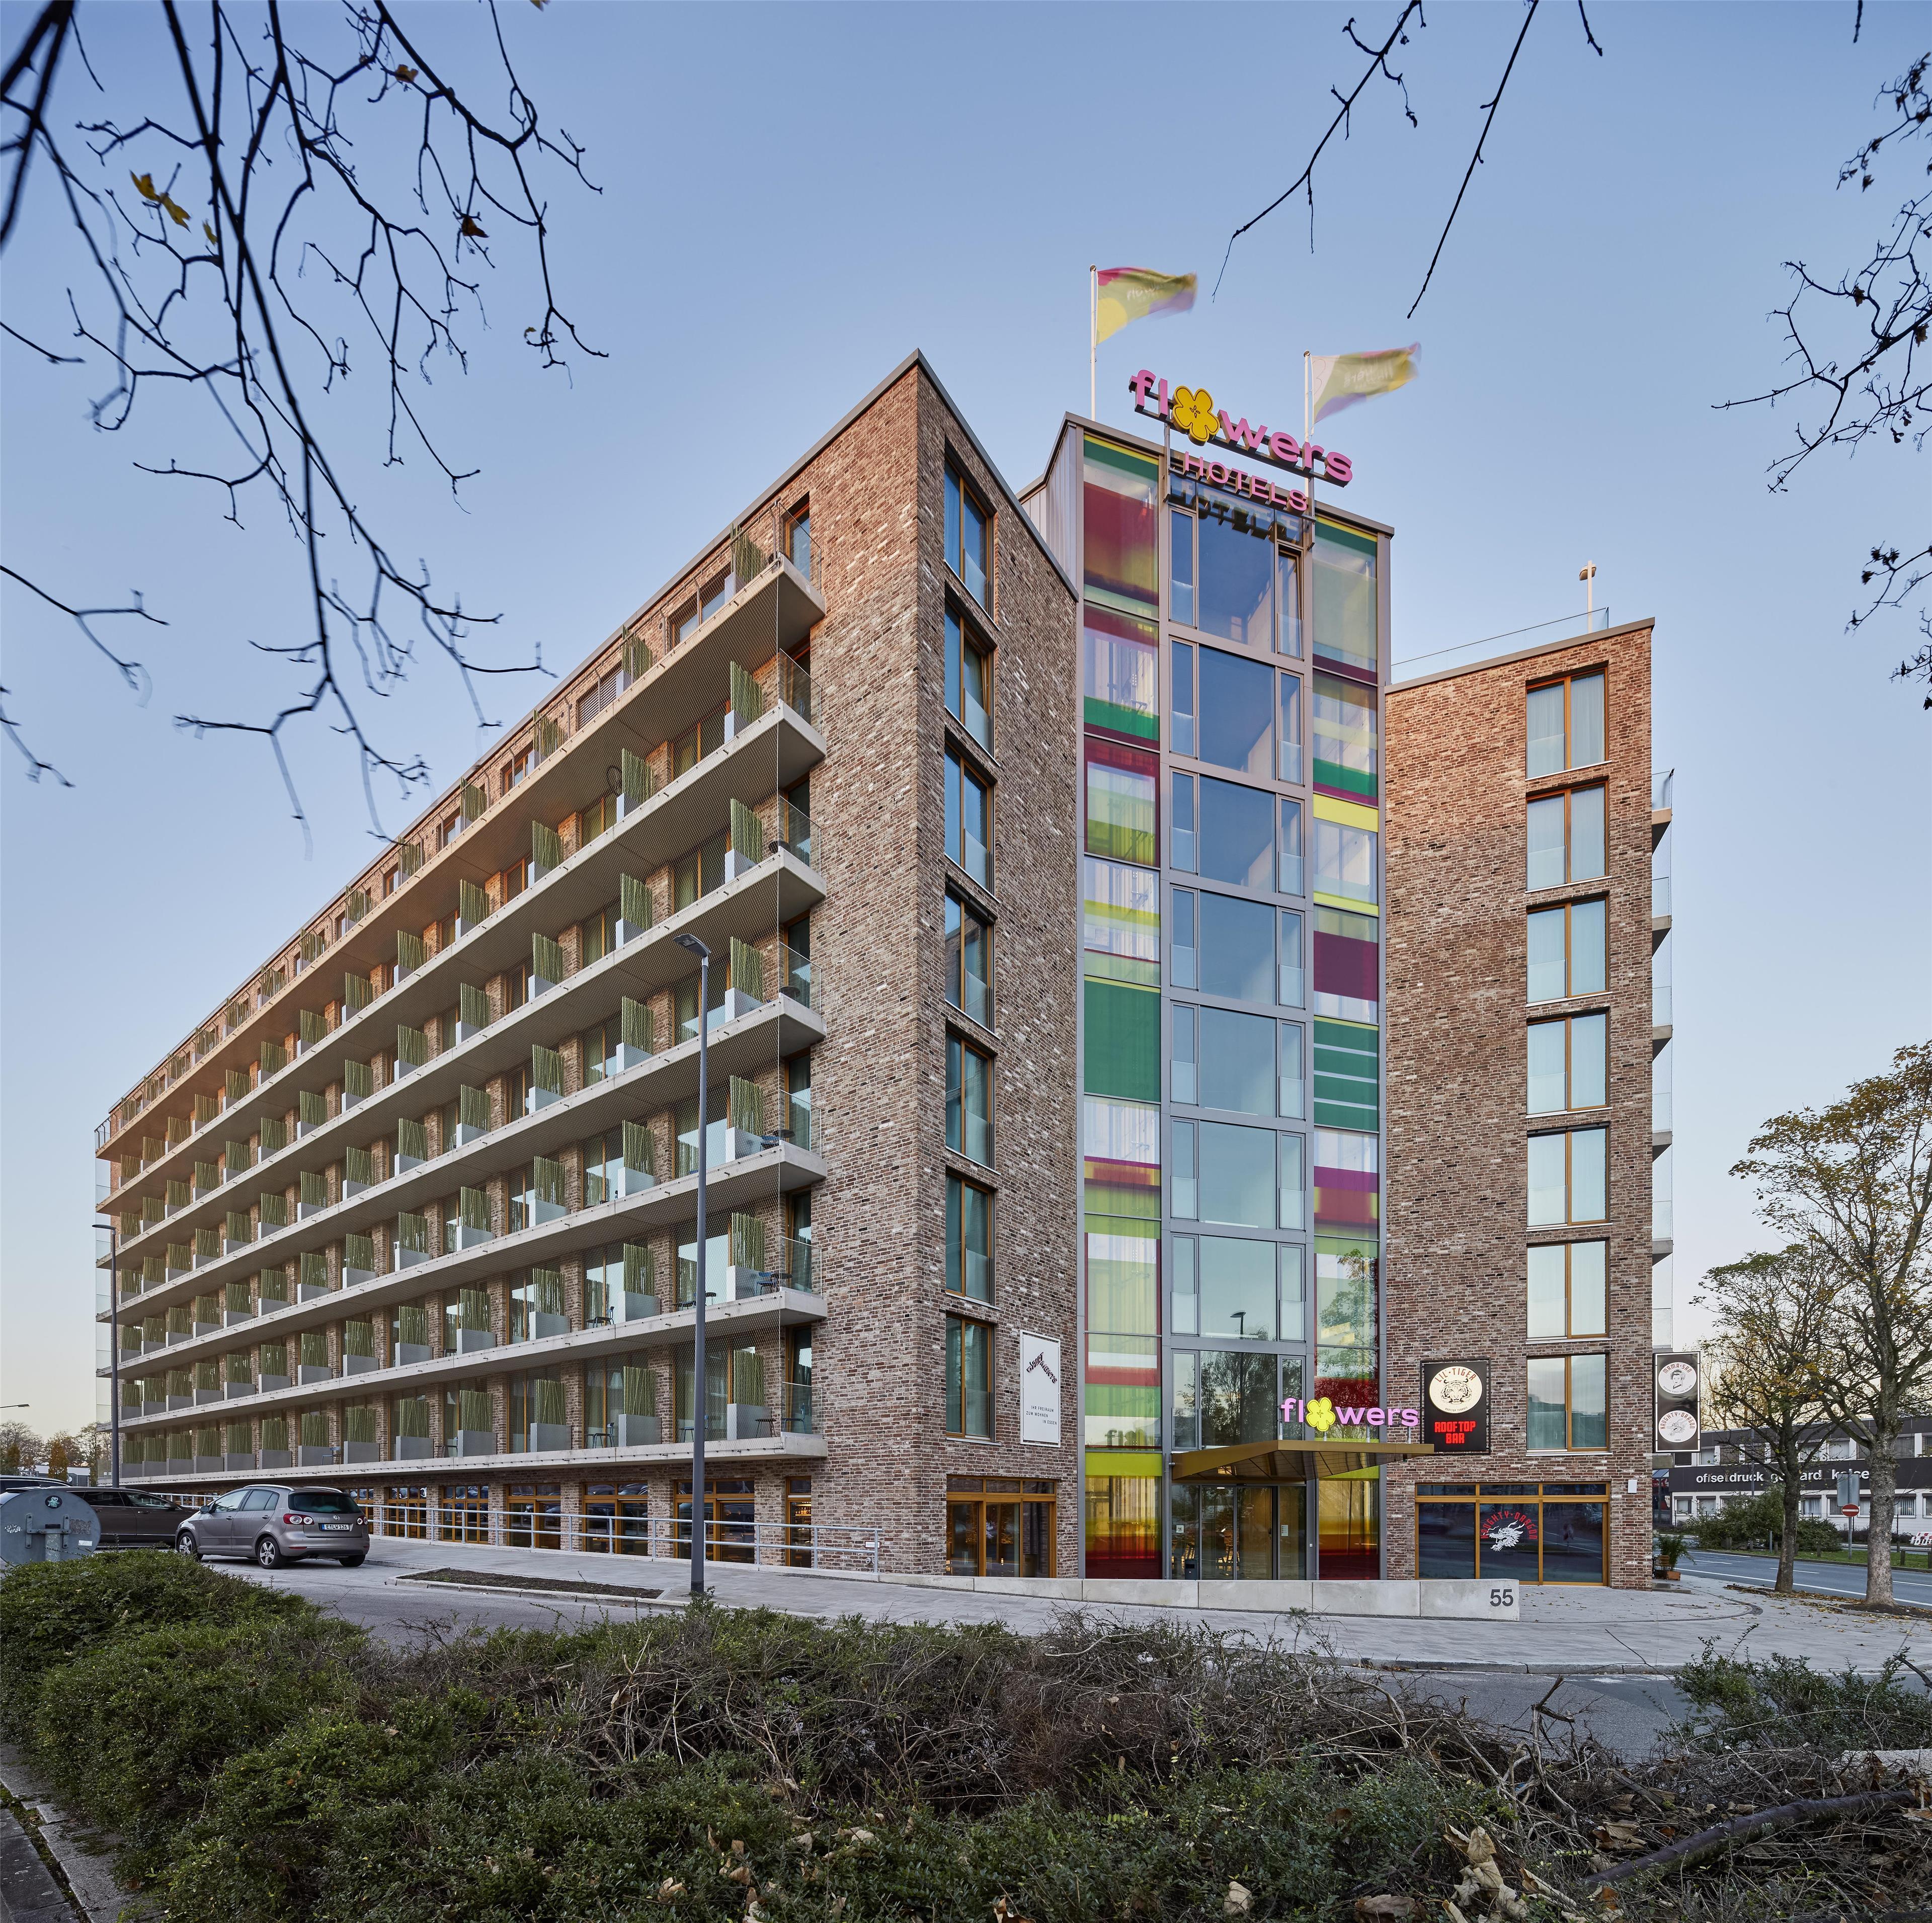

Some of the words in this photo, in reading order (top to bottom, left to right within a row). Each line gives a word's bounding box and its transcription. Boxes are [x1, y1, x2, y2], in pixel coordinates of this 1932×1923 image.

[1183, 451, 1308, 514] HOTELS
[1434, 1421, 1476, 1433] ROOFTOP
[1445, 1433, 1465, 1444] BAR
[1490, 1588, 1513, 1607] 55
